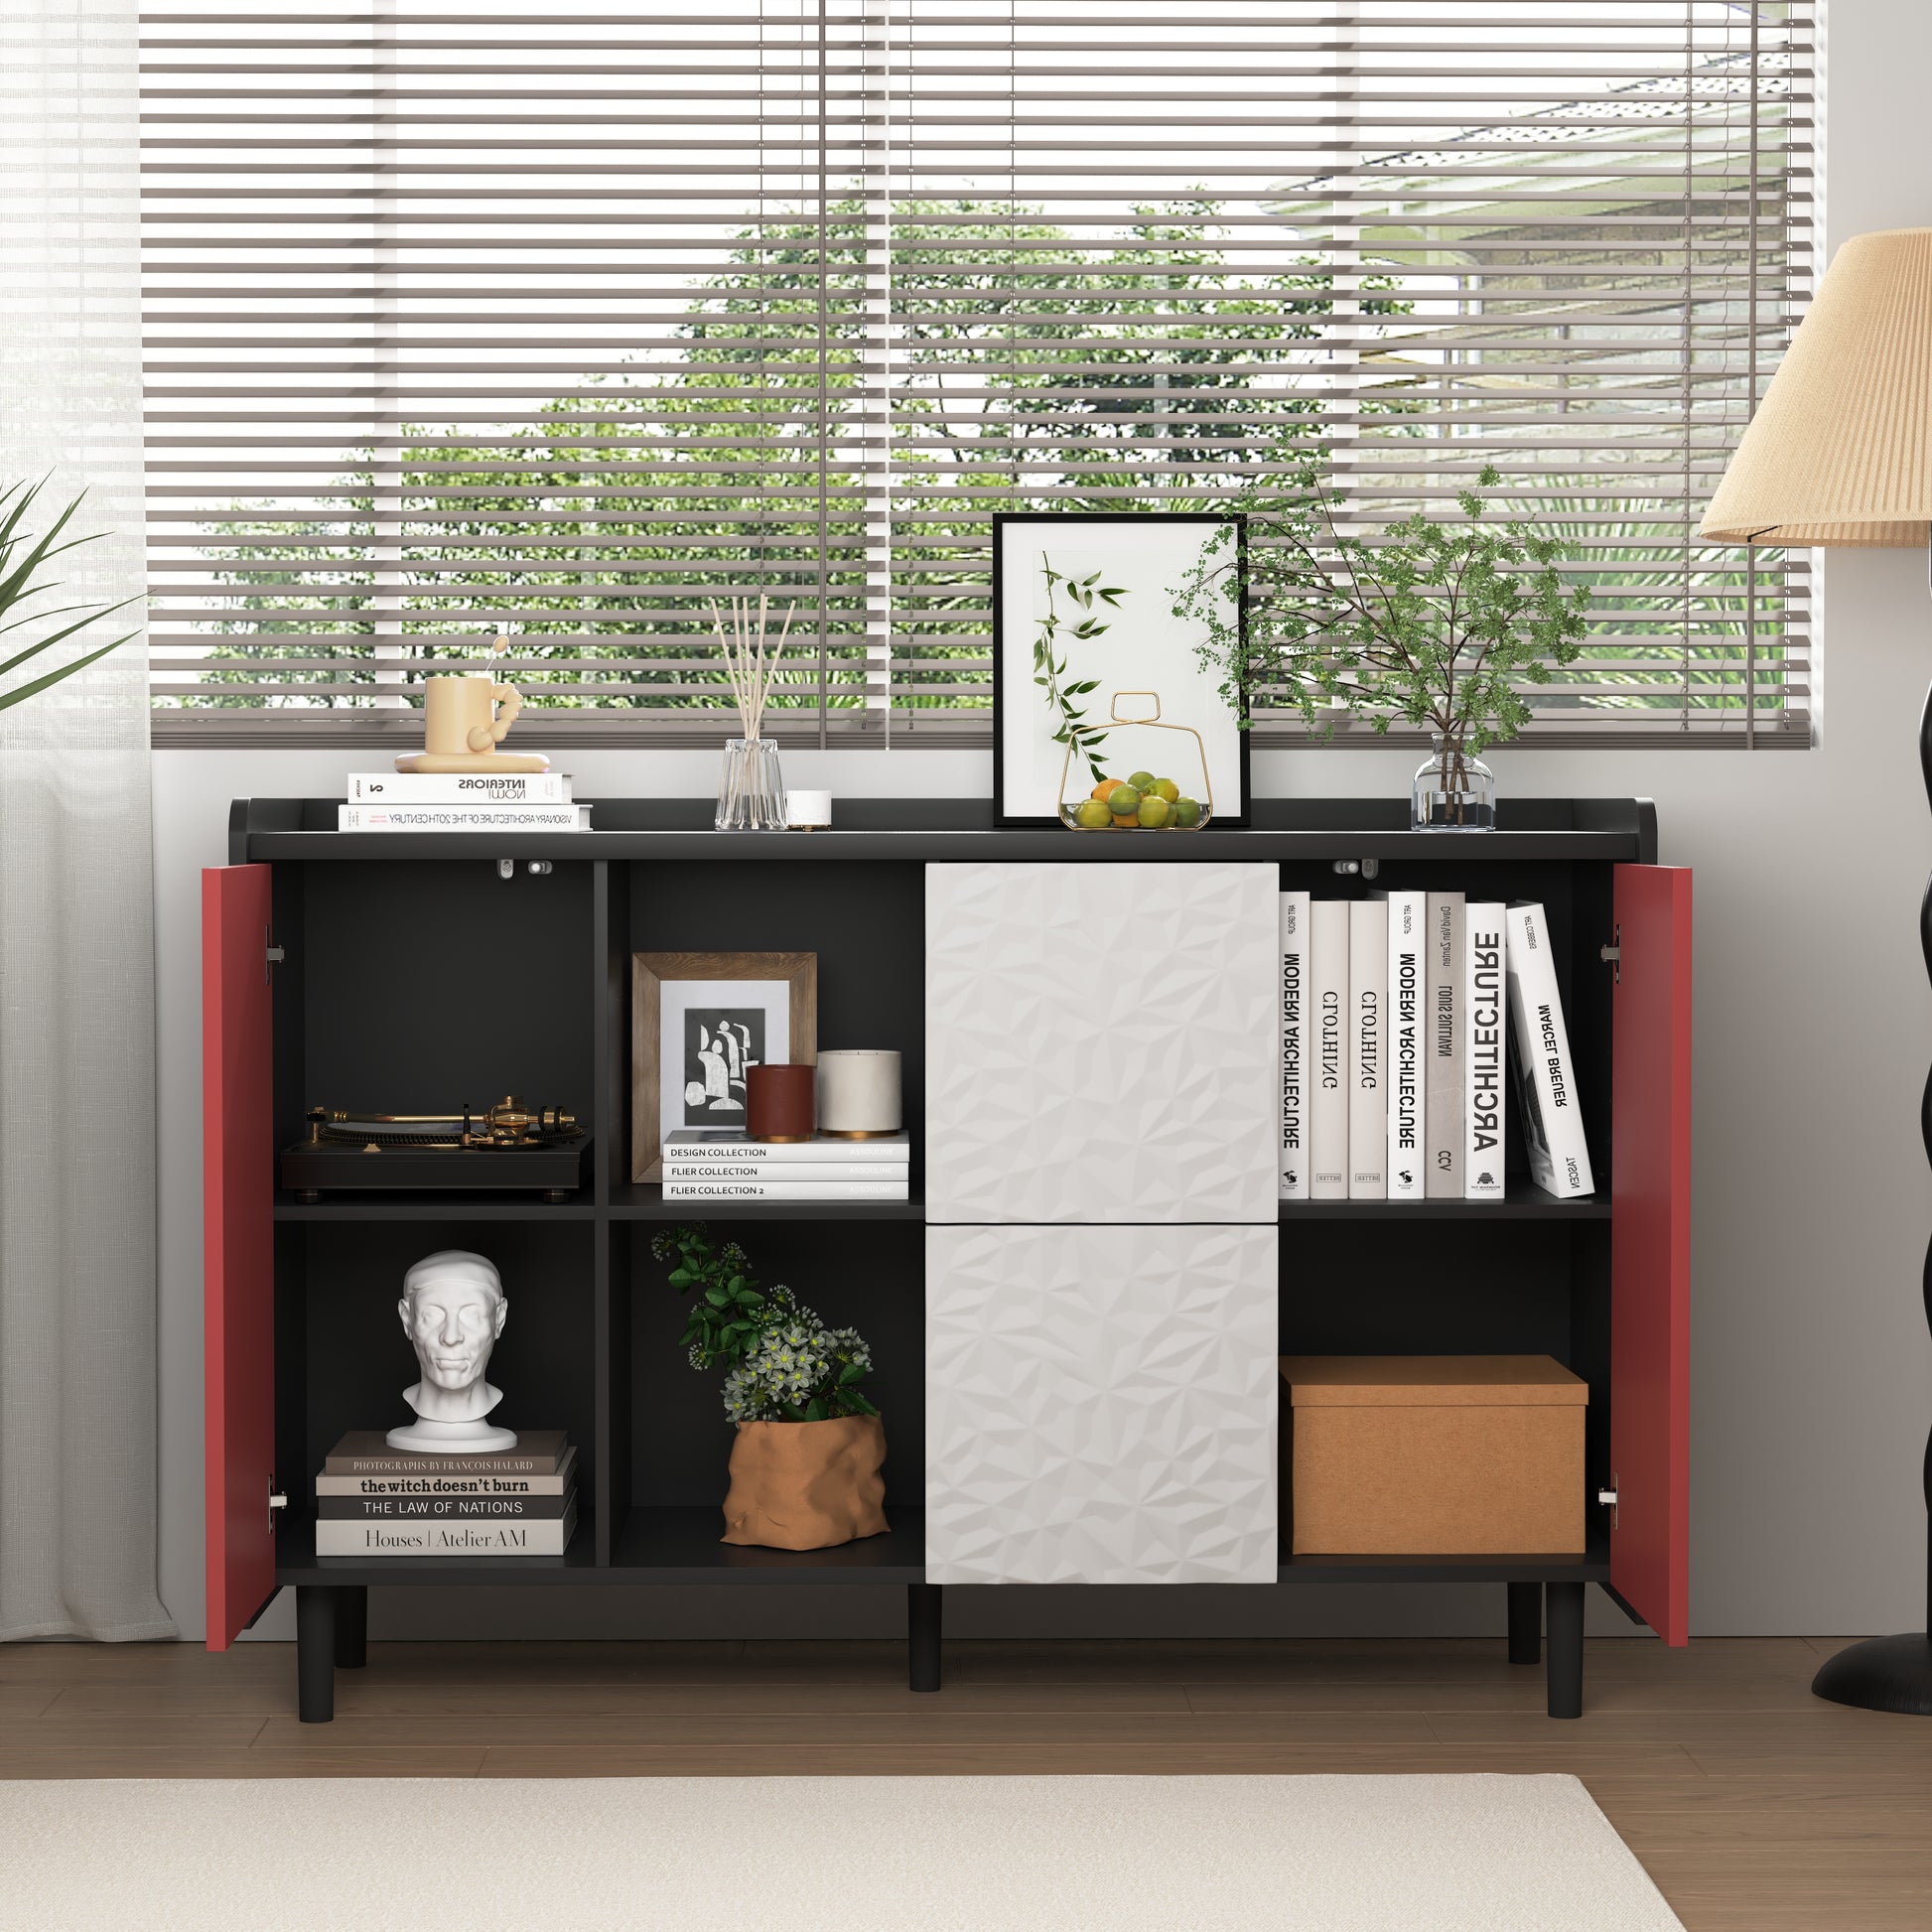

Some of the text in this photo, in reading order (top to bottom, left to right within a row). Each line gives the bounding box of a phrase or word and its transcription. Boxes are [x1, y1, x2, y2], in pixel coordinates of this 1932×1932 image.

[671, 1148, 766, 1157] DESIGN COLLECTION
[353, 1461, 533, 1472] PHOTOGRAPHS BY FRANÇOIS HALARD
[360, 1478, 529, 1493] the witch doesn’t burn
[363, 1501, 523, 1513] THE LAW OF NATIONS
[366, 1530, 422, 1547] Houses
[436, 1530, 491, 1547] Atelier
[494, 1530, 526, 1547] AM
